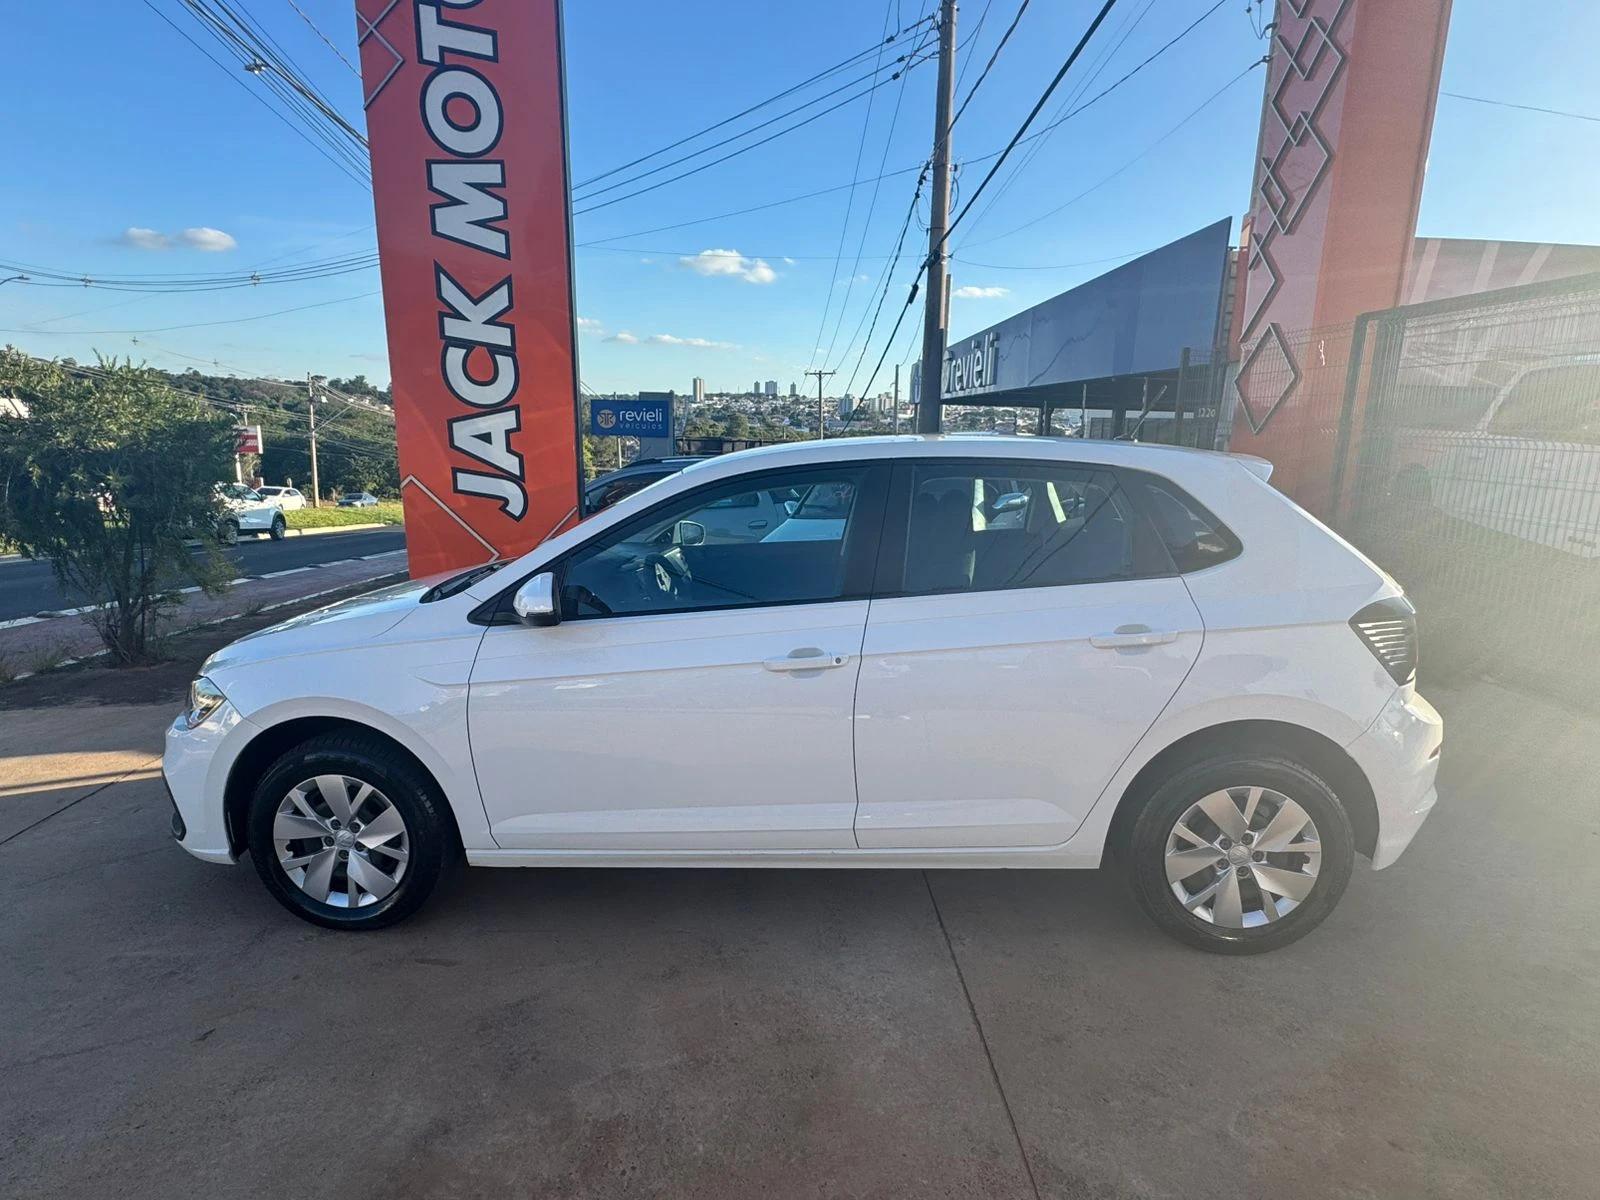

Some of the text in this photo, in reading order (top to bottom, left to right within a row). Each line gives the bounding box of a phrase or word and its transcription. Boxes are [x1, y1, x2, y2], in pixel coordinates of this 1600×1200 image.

[413, 0, 528, 522] JACK MOT
[949, 332, 993, 392] revieli
[619, 408, 662, 421] revieli
